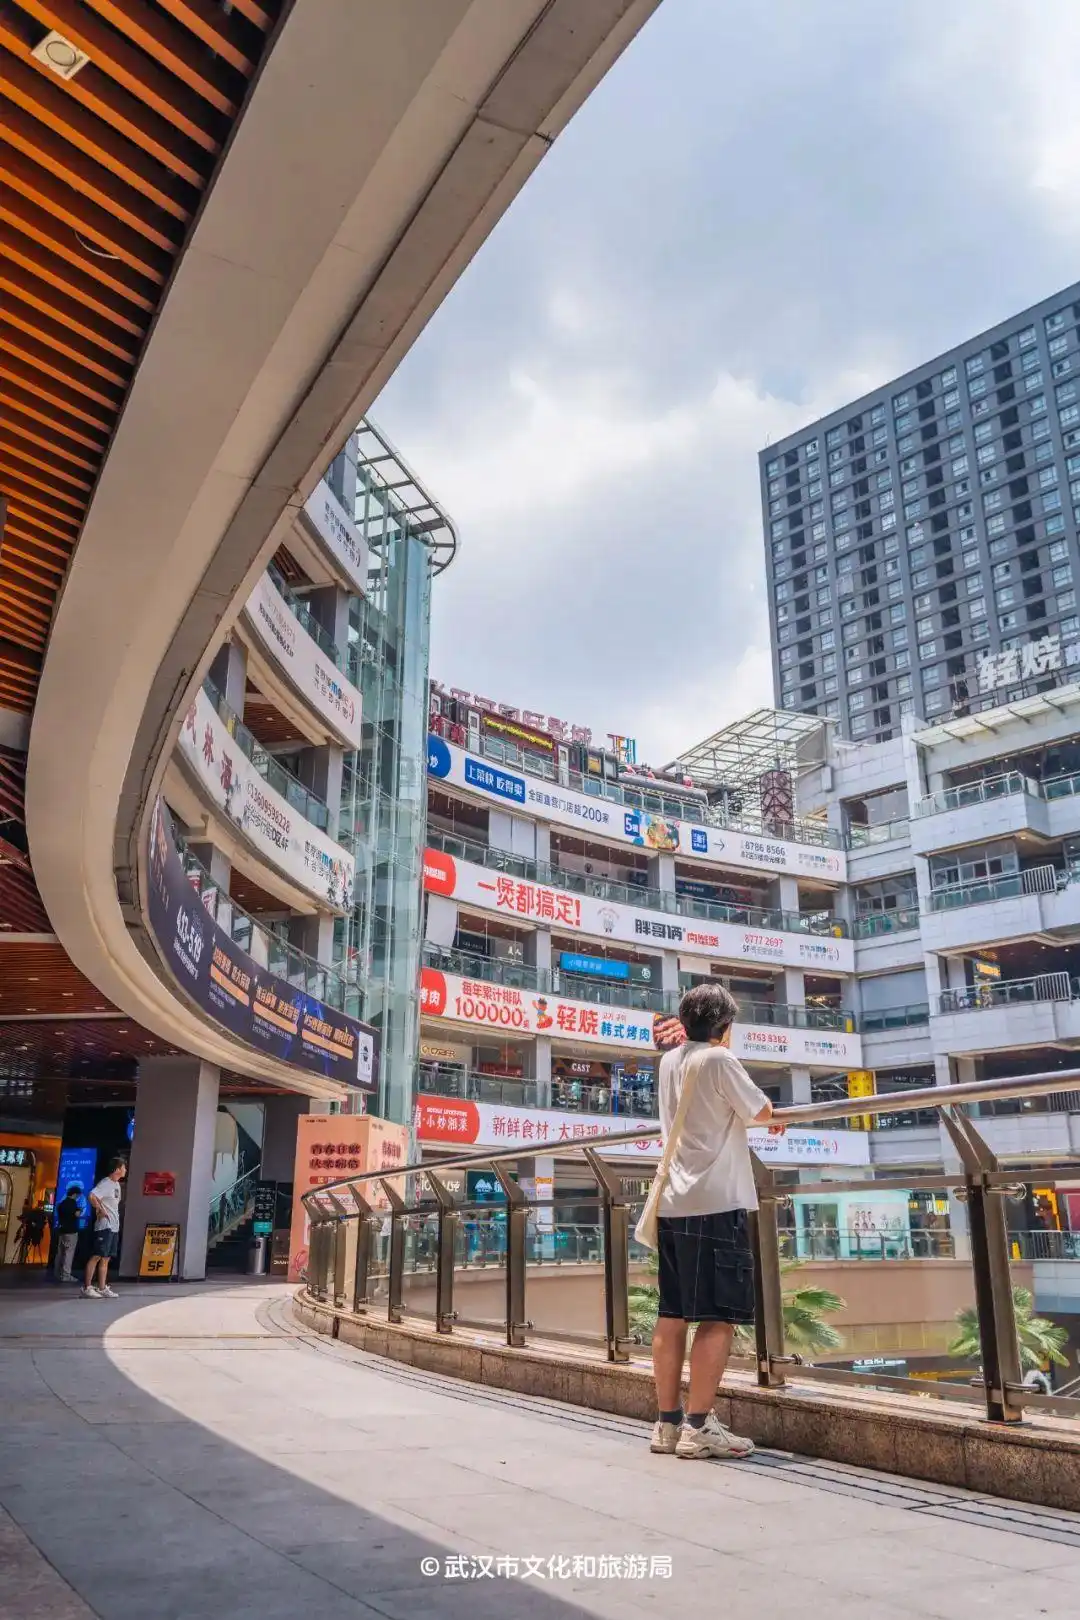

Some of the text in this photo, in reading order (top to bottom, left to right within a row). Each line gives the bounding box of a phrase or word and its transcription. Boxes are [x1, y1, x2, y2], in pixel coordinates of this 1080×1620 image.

[528, 788, 609, 824] 全国直营门店超200家
[635, 919, 682, 941] 胖哥俩
[462, 981, 522, 1006] 每年累计排队
[557, 1004, 599, 1036] 轻烧
[601, 1021, 650, 1043] 韩式烤肉
